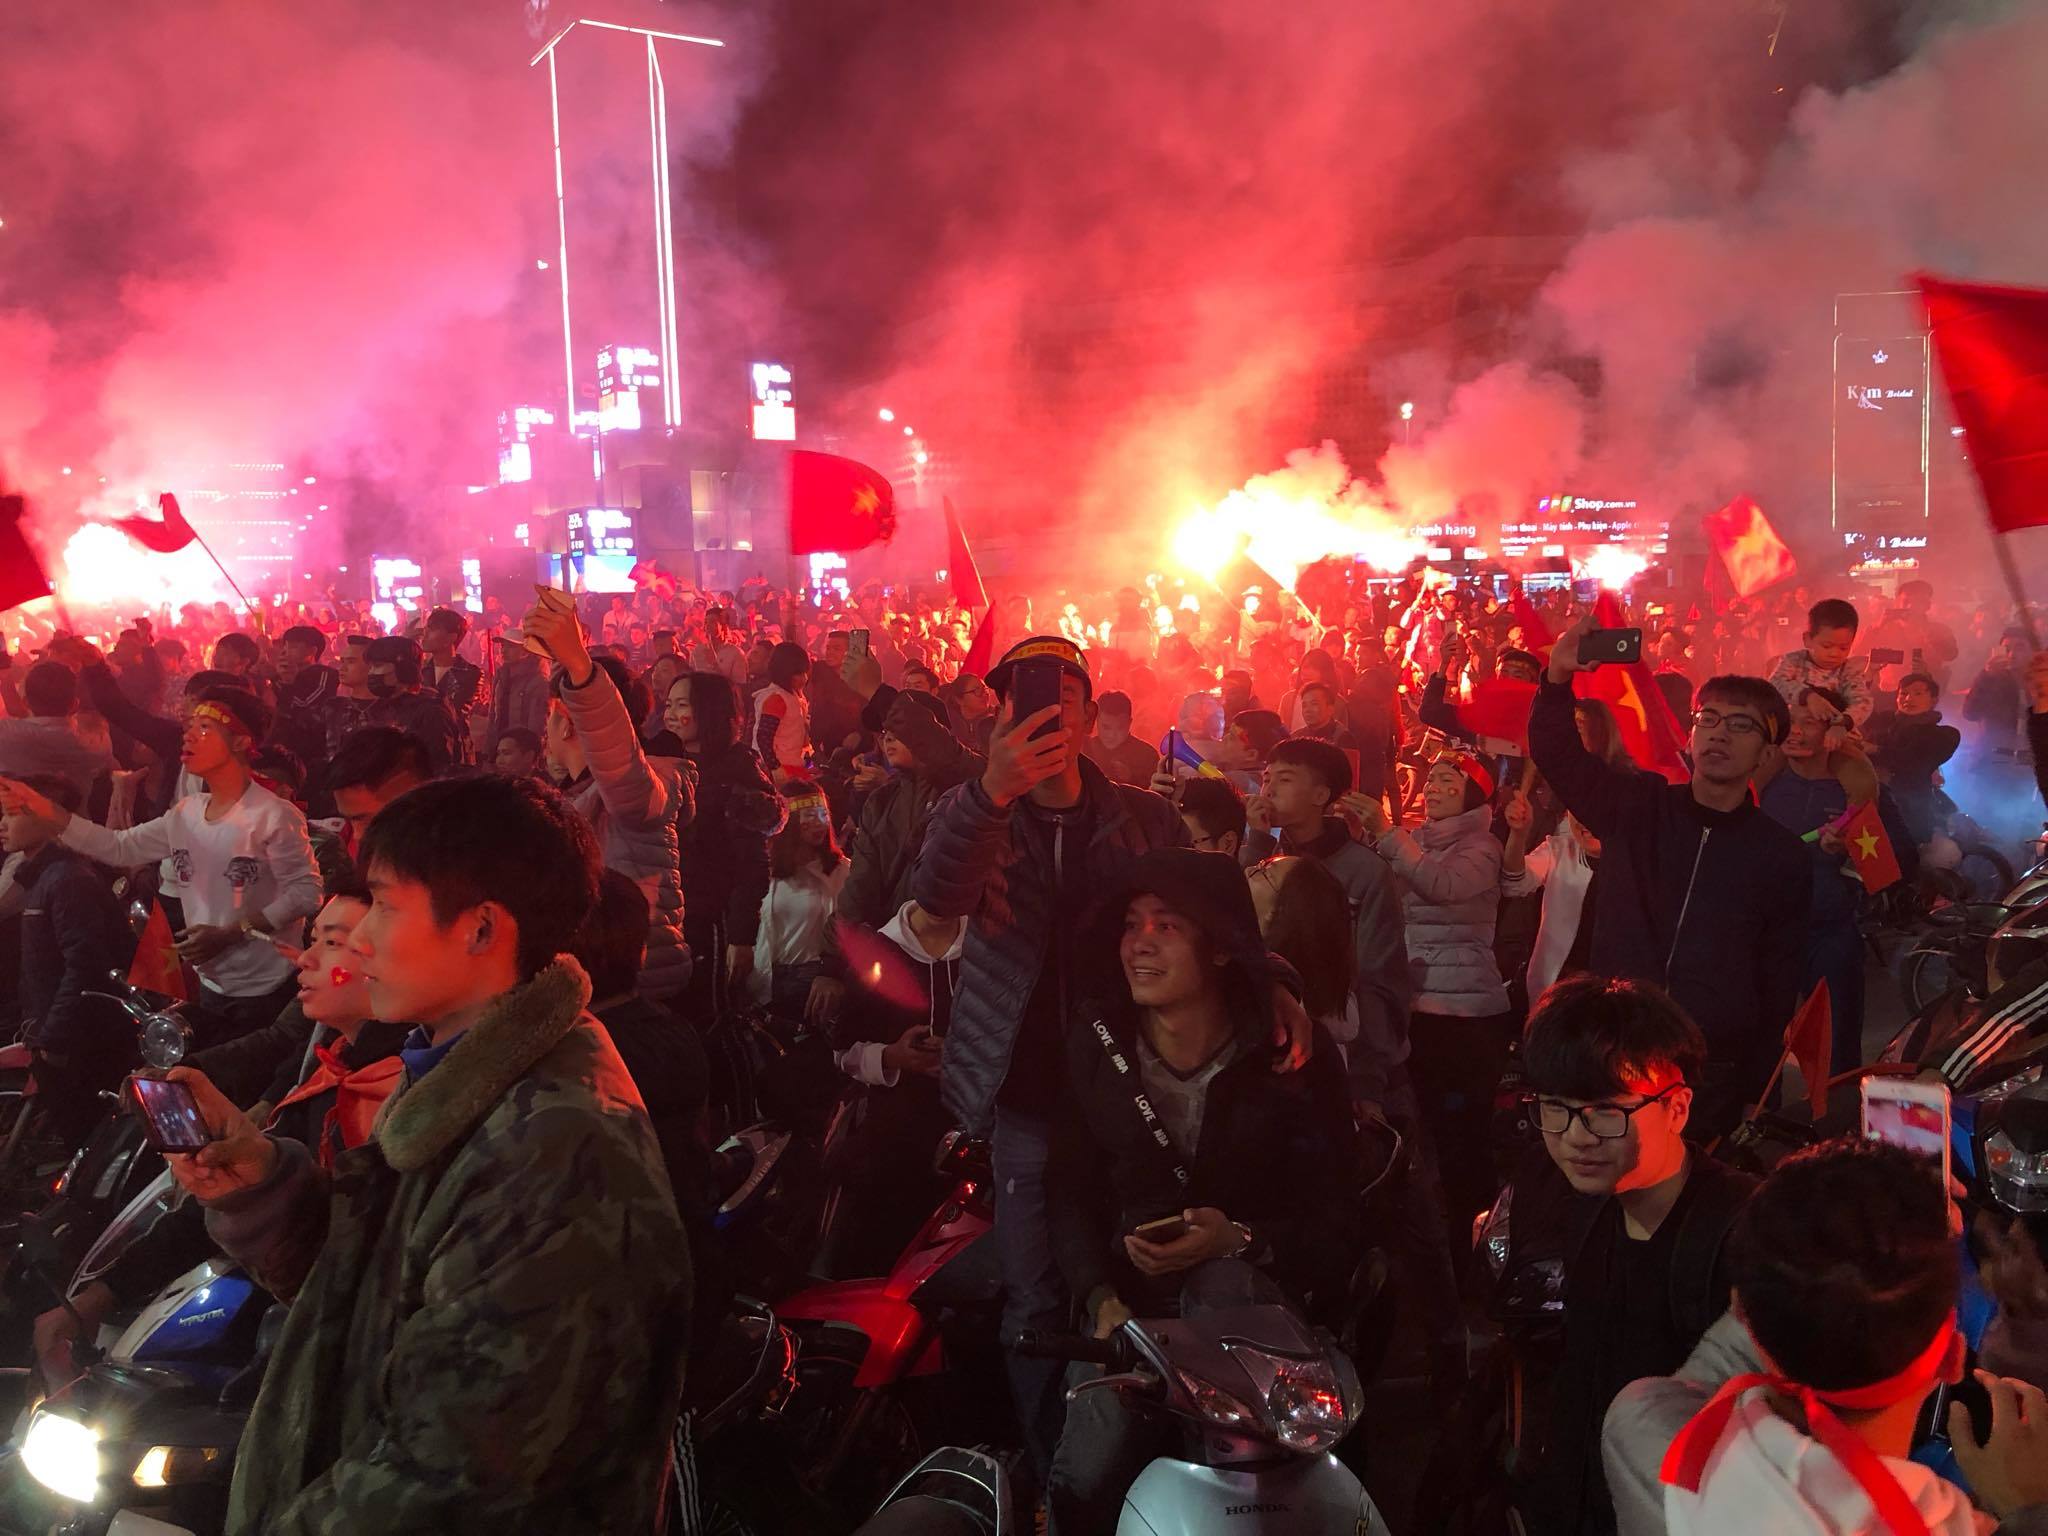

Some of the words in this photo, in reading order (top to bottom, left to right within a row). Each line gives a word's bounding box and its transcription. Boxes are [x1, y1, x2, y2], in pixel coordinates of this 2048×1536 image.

[1574, 497, 1637, 511] Shop.com.vn
[1092, 1019, 1115, 1047] LOVE
[1111, 1053, 1129, 1074] NBA
[1134, 1094, 1156, 1122] LOVE
[1225, 1503, 1293, 1516] HONDA
